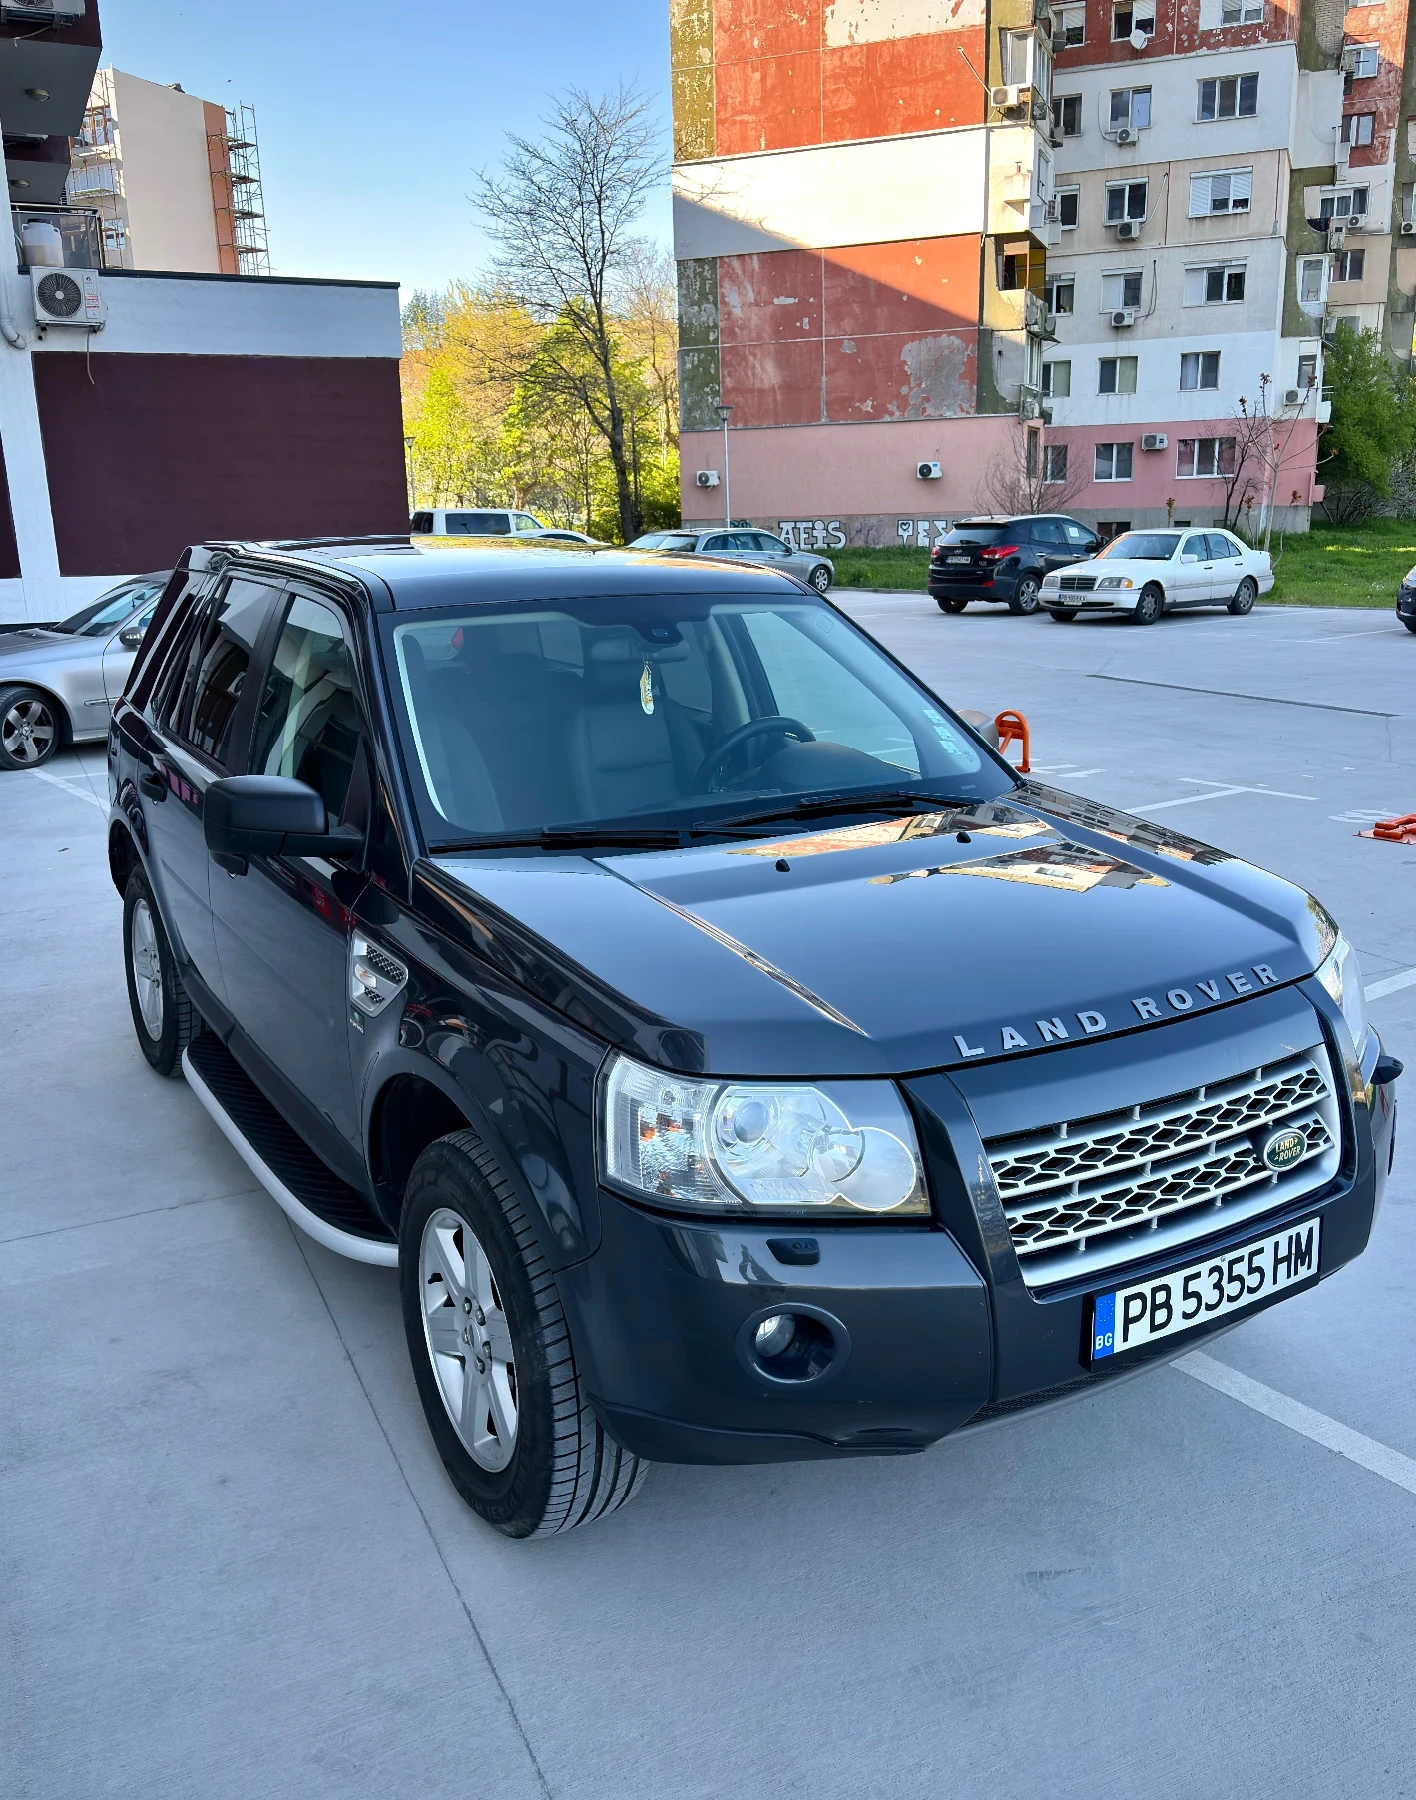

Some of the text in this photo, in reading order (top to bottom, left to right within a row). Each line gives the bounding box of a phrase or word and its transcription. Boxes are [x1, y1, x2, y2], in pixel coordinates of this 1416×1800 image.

[953, 963, 1279, 1058] LAND ROVER
[1275, 1138, 1294, 1153] LAND
[1279, 1146, 1301, 1162] ROVER
[1122, 1226, 1314, 1343] PB 5355 HM
[1095, 1332, 1113, 1350] BG
